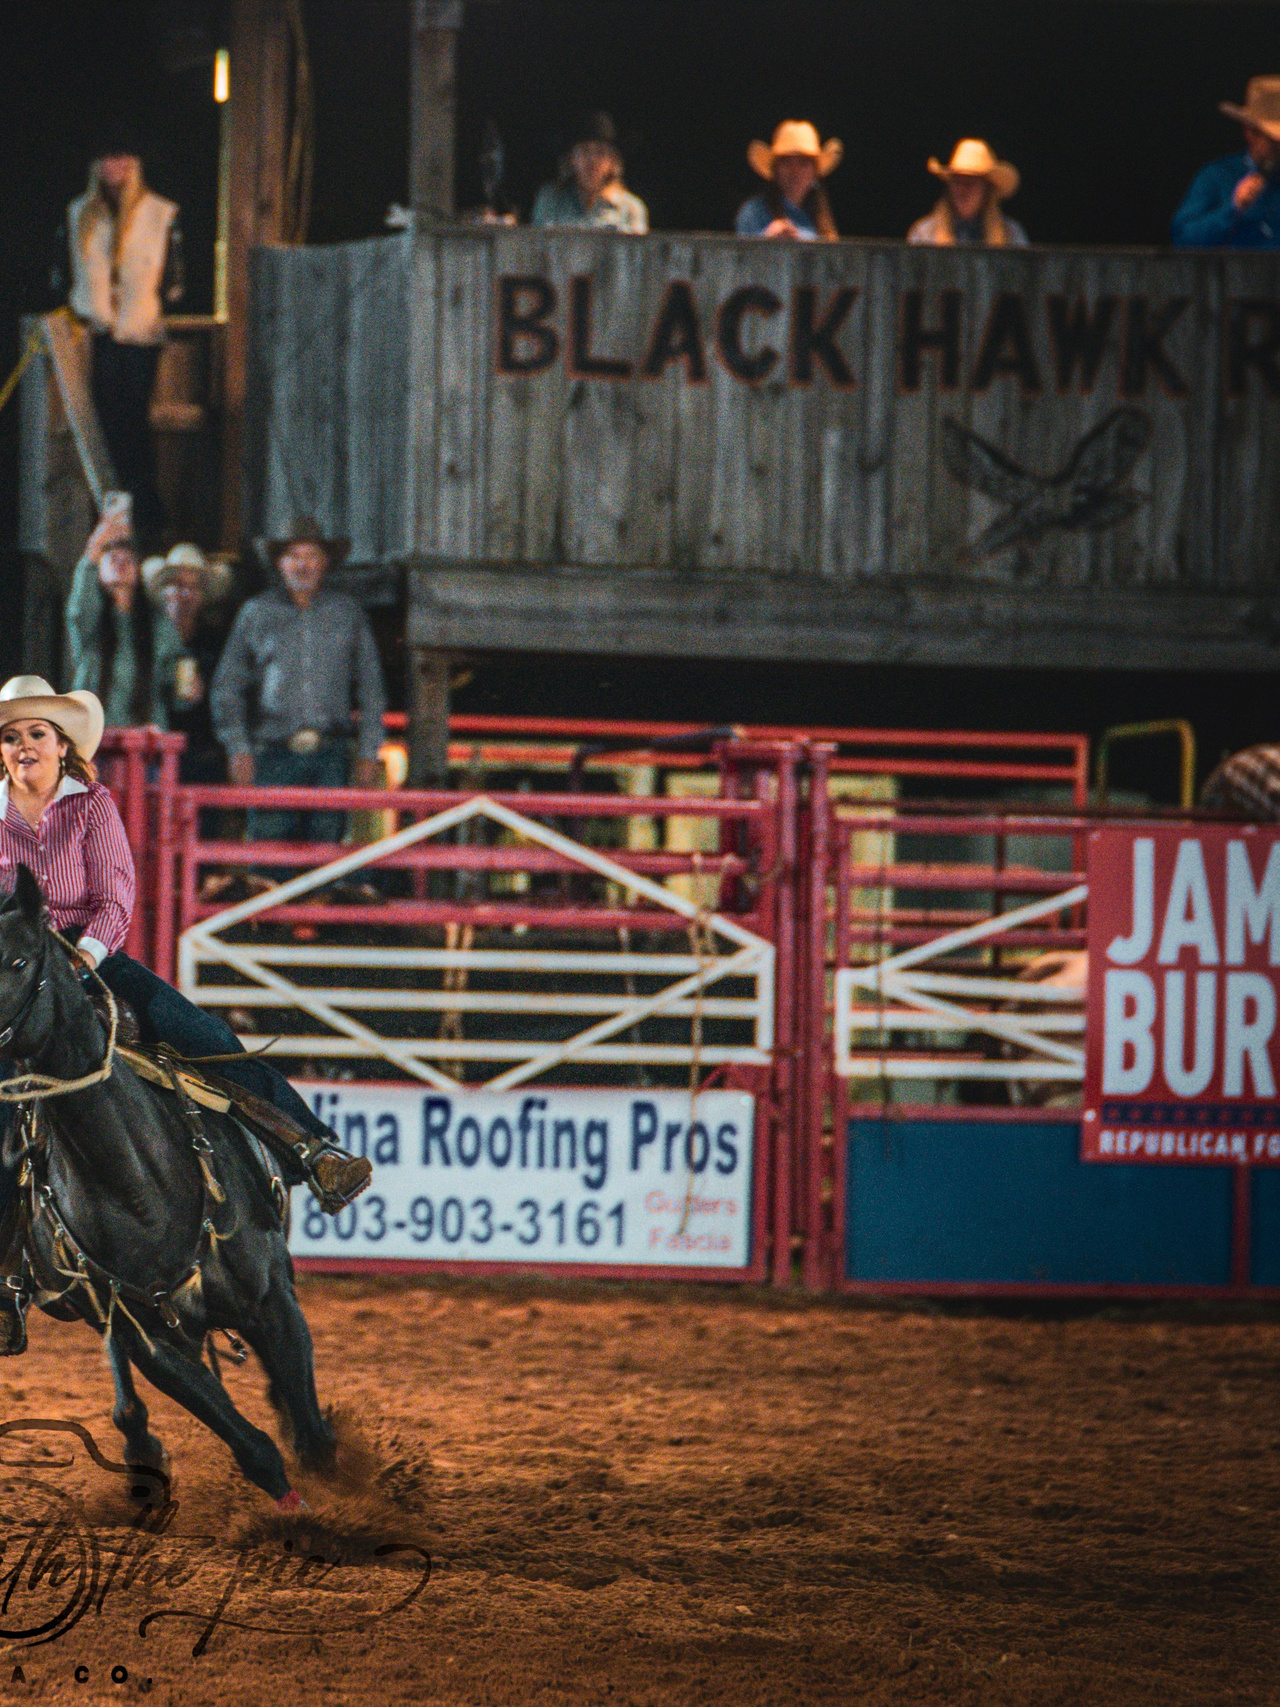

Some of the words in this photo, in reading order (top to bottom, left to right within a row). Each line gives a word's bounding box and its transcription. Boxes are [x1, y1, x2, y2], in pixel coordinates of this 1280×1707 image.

[496, 274, 860, 392] BLACK
[898, 284, 1192, 398] HAWK
[422, 1096, 610, 1190] Roofing
[630, 1102, 739, 1176] Pros
[302, 1194, 626, 1248] 803-903-3161
